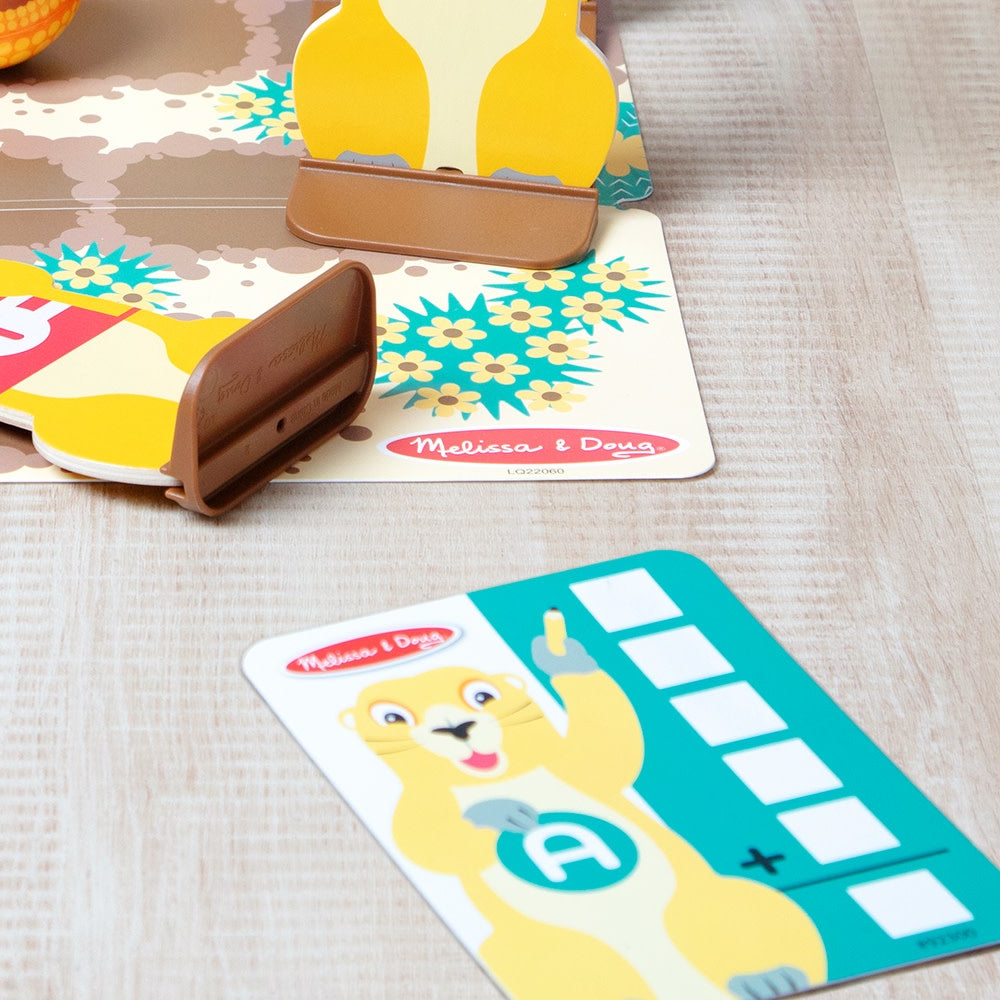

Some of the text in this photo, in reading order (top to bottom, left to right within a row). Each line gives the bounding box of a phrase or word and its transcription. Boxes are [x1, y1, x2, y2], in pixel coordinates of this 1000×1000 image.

[410, 436, 656, 458] Melissa & Doug
[506, 467, 565, 475] LQ22060
[296, 648, 378, 672] Melissa
[394, 631, 446, 651] Doug
[522, 821, 622, 884] A
